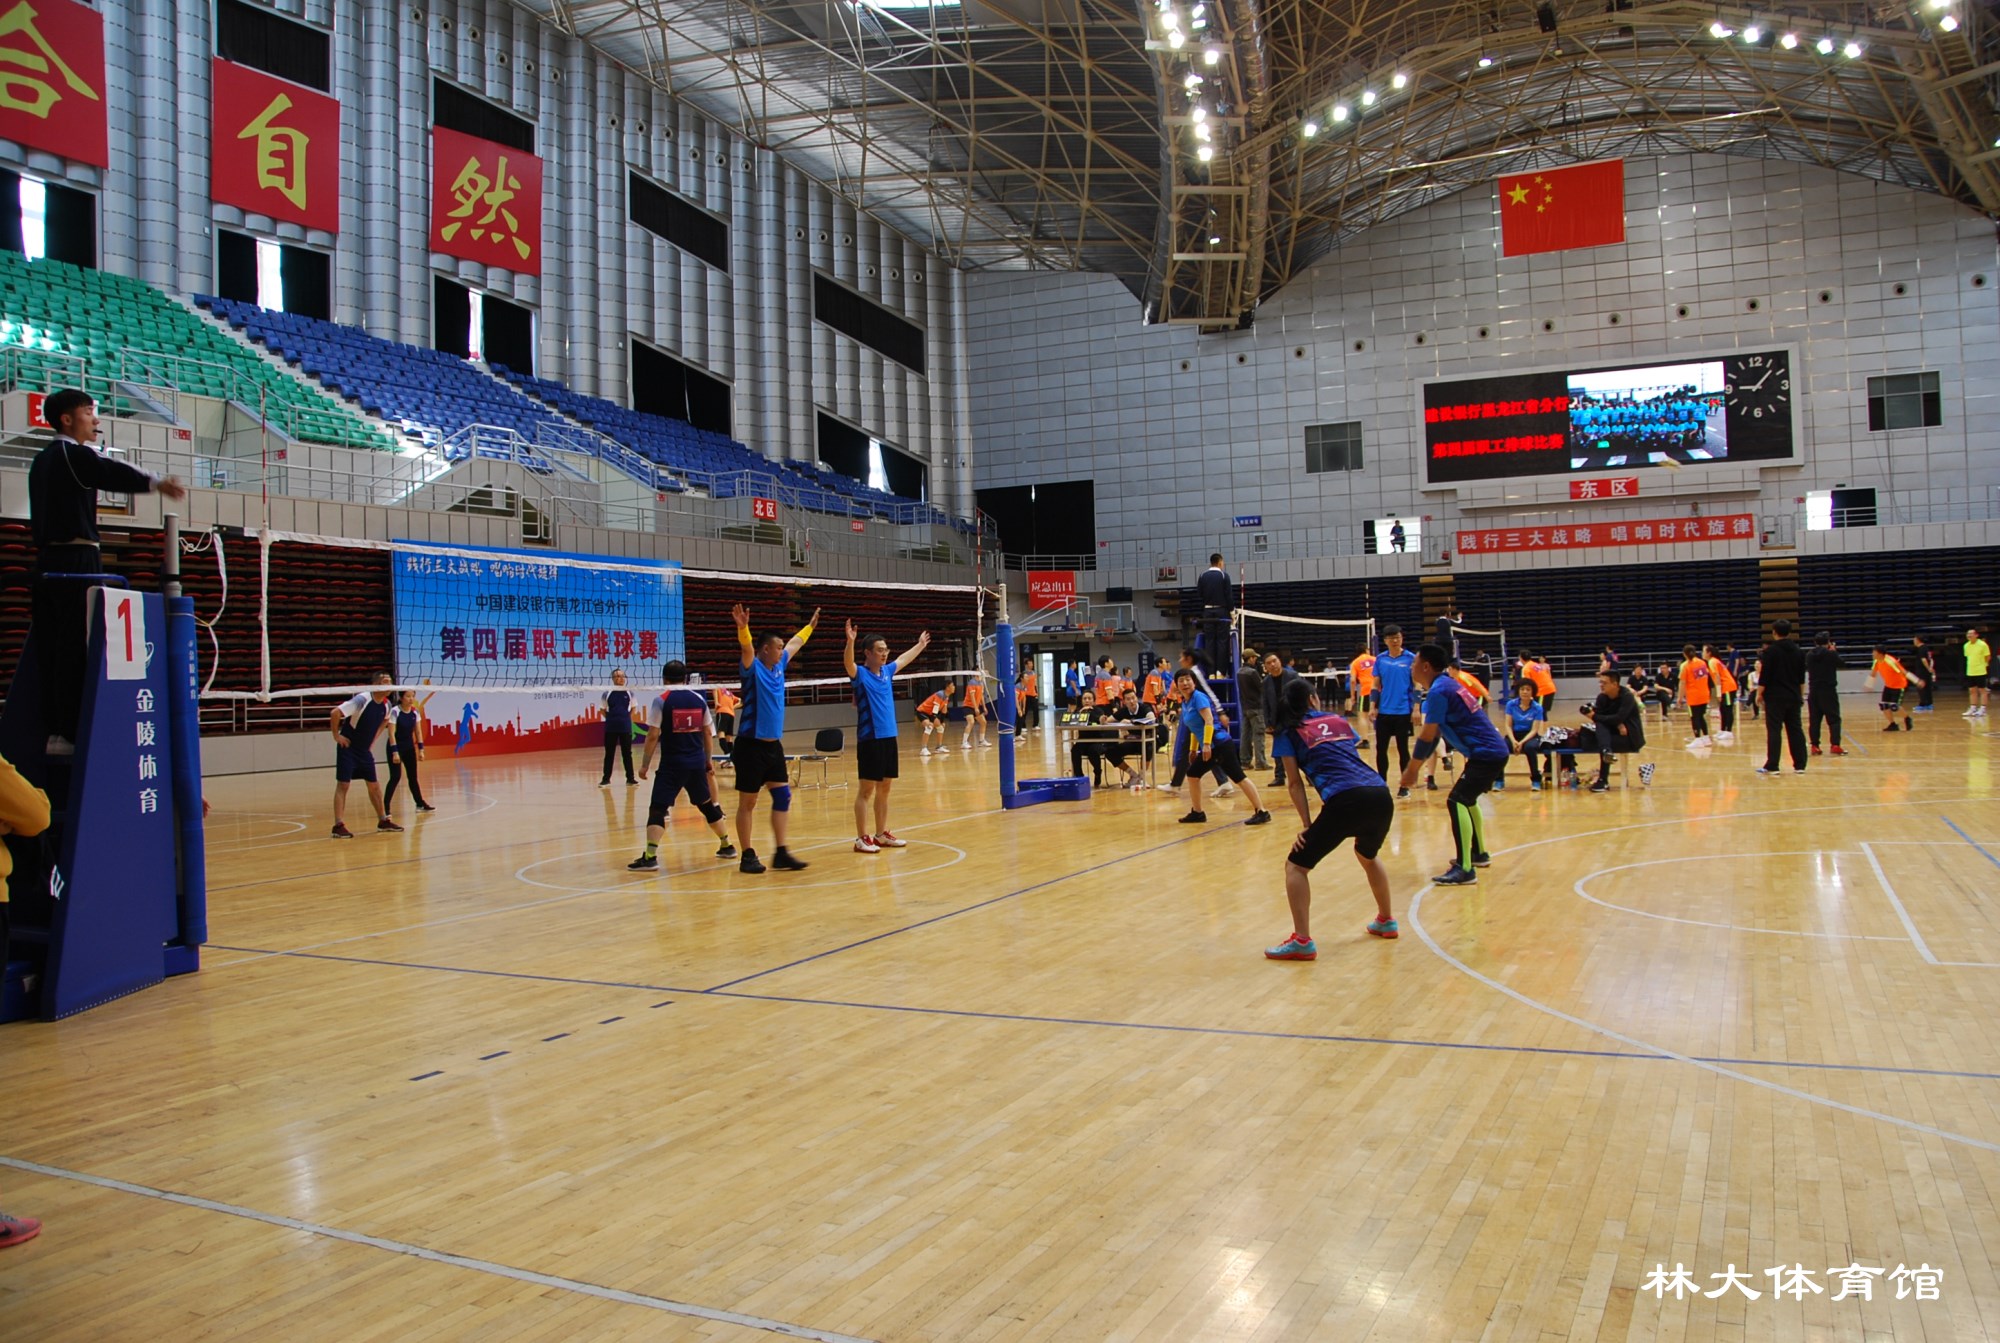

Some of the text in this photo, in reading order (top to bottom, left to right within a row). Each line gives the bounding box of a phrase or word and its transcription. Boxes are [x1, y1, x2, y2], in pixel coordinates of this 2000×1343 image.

[237, 93, 309, 211] 自
[440, 155, 531, 261] 然
[1748, 356, 1762, 368] 12
[1725, 384, 1733, 394] 9
[1780, 380, 1789, 390] 3
[1753, 407, 1762, 418] 6
[1433, 433, 1565, 459] 第四届职工排球比赛
[1580, 480, 1629, 499] 东区
[755, 500, 775, 517] 北区
[1461, 518, 1751, 550] 践行三大战略 唱响时代旋律
[1031, 581, 1072, 592] 应急出口
[475, 594, 629, 615] 中国建设银行黑龙江省分行
[117, 598, 133, 662] 1
[440, 626, 659, 661] 第四届职工排球赛
[686, 716, 692, 727] 1
[1317, 723, 1333, 736] 2
[136, 688, 158, 814] 金陵体育
